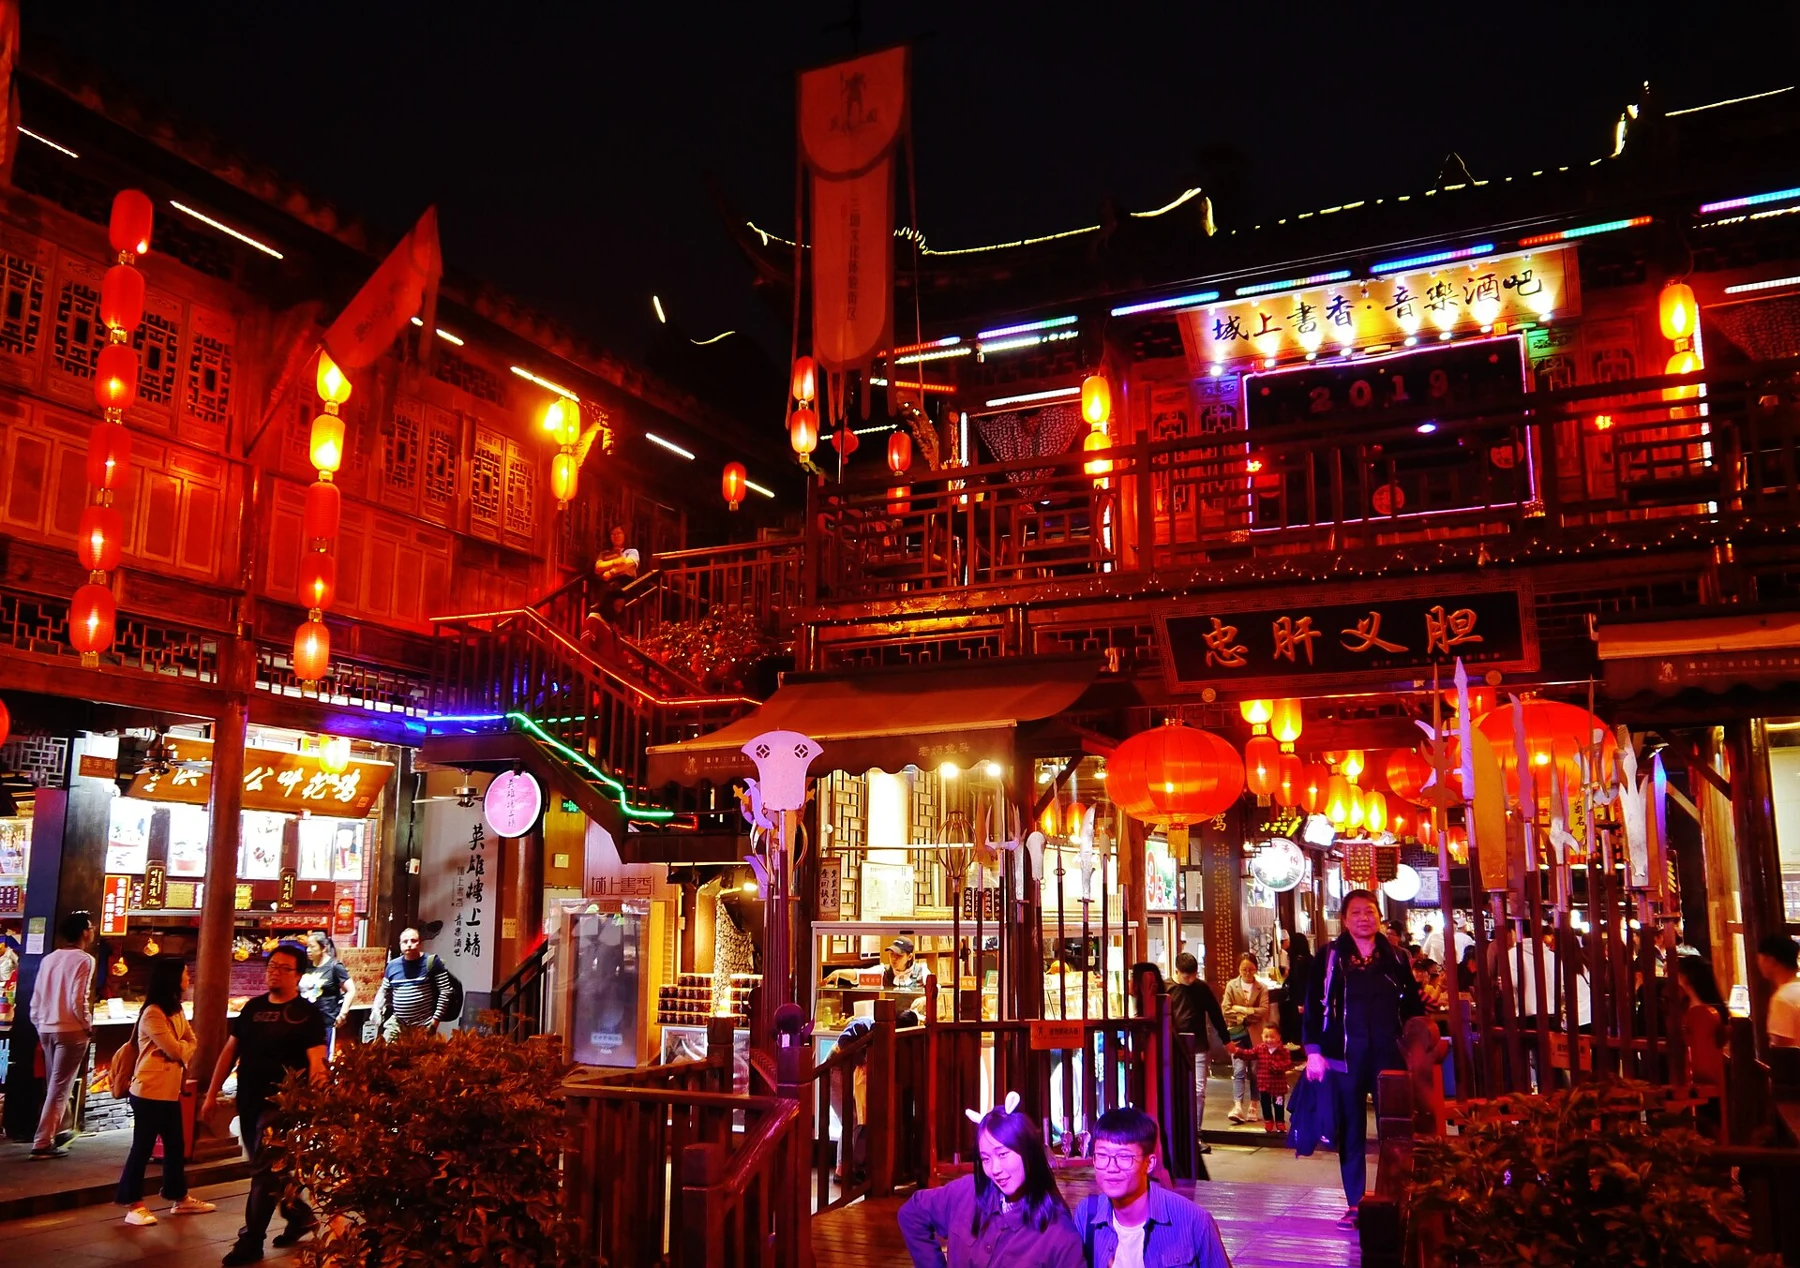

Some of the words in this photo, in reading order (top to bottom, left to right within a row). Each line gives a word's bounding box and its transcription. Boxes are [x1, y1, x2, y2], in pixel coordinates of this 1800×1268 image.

[1310, 370, 1448, 413] 2019
[1202, 605, 1484, 668] 忠肝义胆
